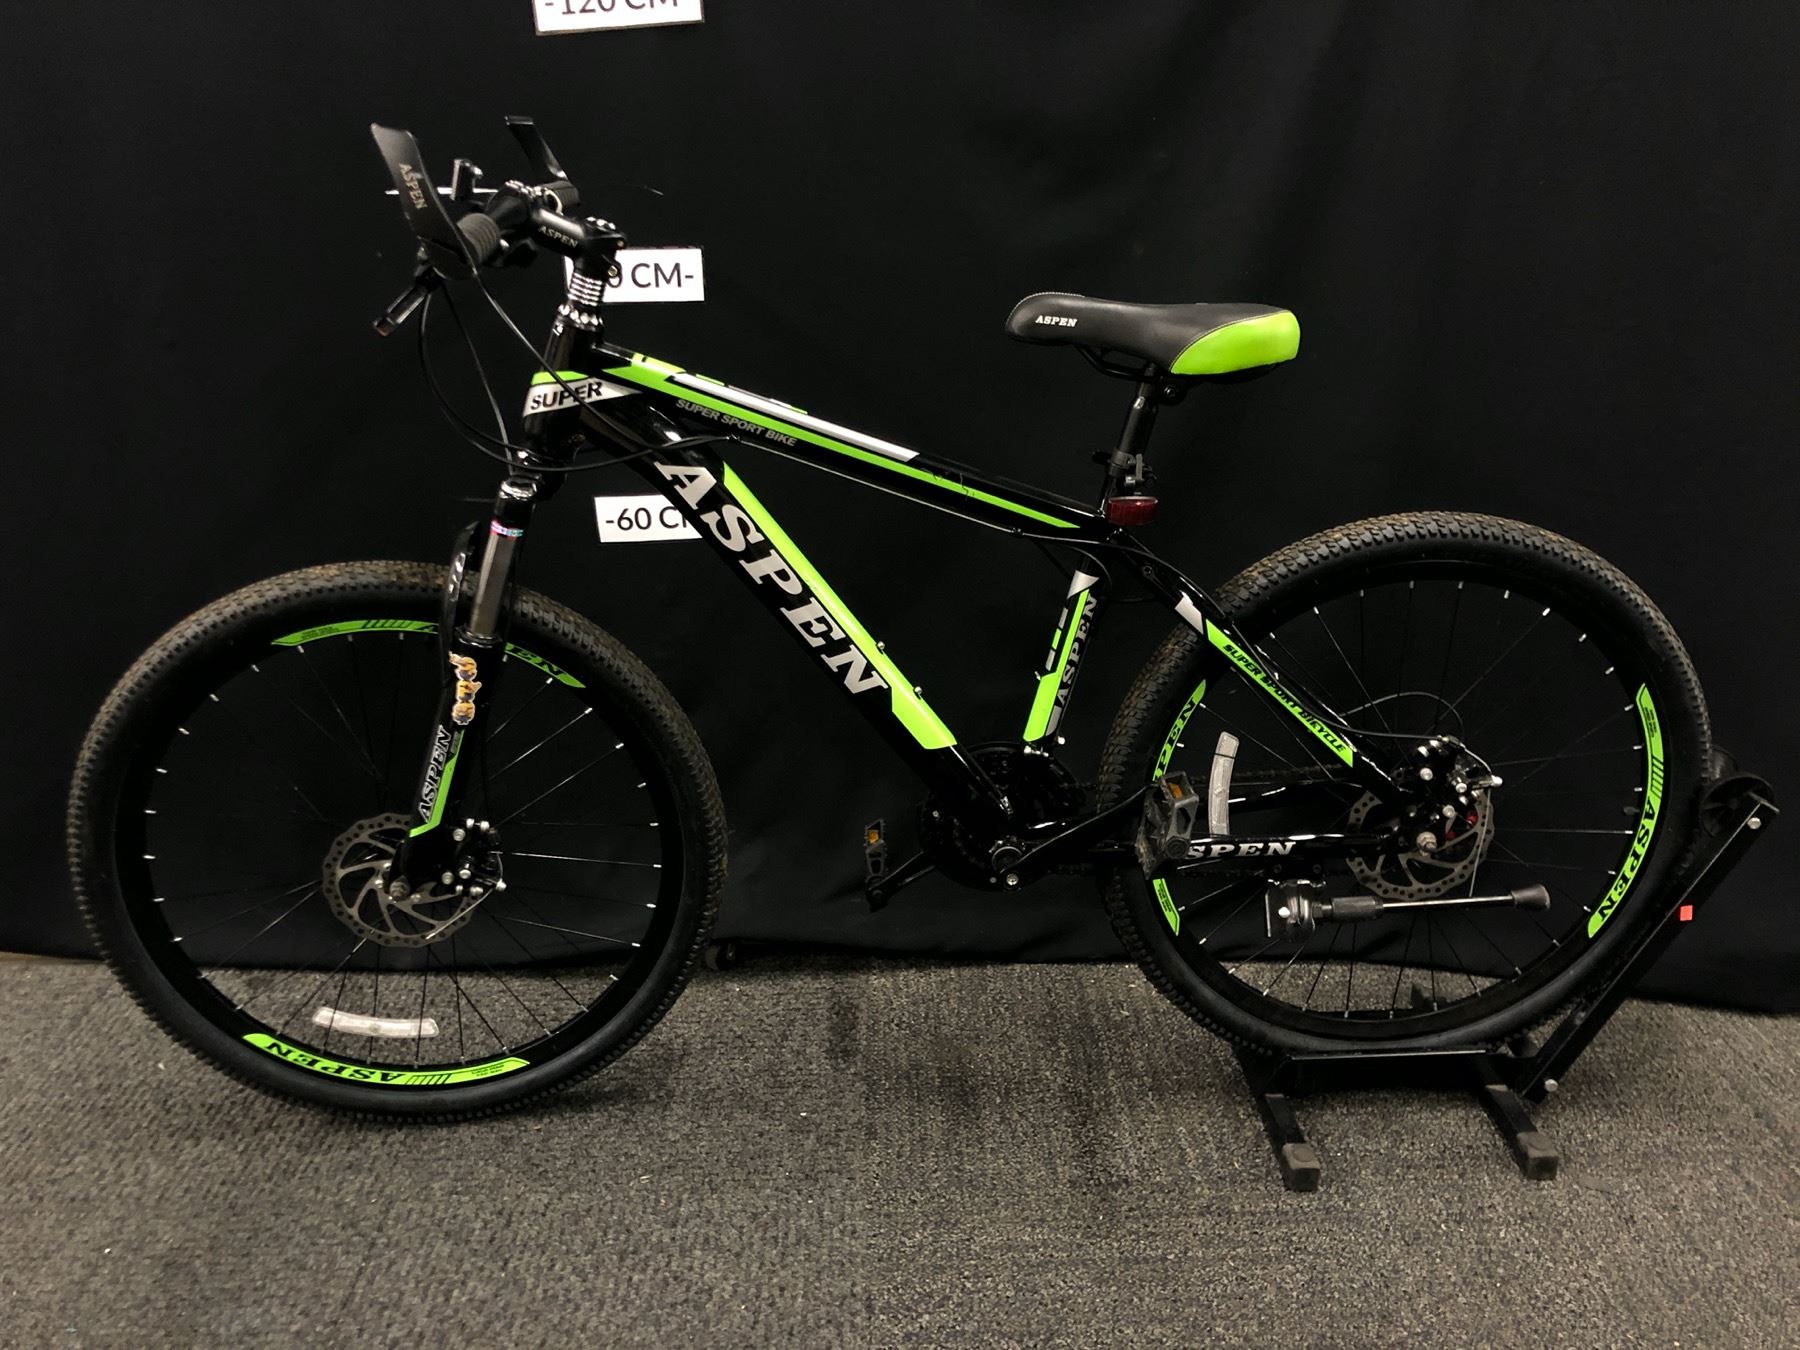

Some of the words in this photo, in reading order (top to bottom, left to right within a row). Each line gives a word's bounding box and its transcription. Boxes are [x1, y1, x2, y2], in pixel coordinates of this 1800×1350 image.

[399, 163, 428, 208] ASPEN
[538, 225, 578, 248] ASPEN
[630, 262, 694, 288] CM-
[1035, 314, 1078, 328] ASPEN
[530, 381, 603, 410] SUPER
[676, 399, 721, 420] SUPER
[721, 414, 765, 435] SPORT
[765, 429, 797, 447] BIKE
[605, 507, 652, 531] -60
[659, 506, 687, 529] C
[654, 461, 888, 694] ASPEN
[1056, 592, 1098, 708] ASPEN
[1222, 642, 1263, 677] SUPER
[1258, 674, 1300, 710] SPORT
[419, 724, 452, 824] ASPEN
[1184, 841, 1297, 860] SPEN
[1598, 799, 1656, 921] ASPEN
[266, 1041, 406, 1083] ASPEN
